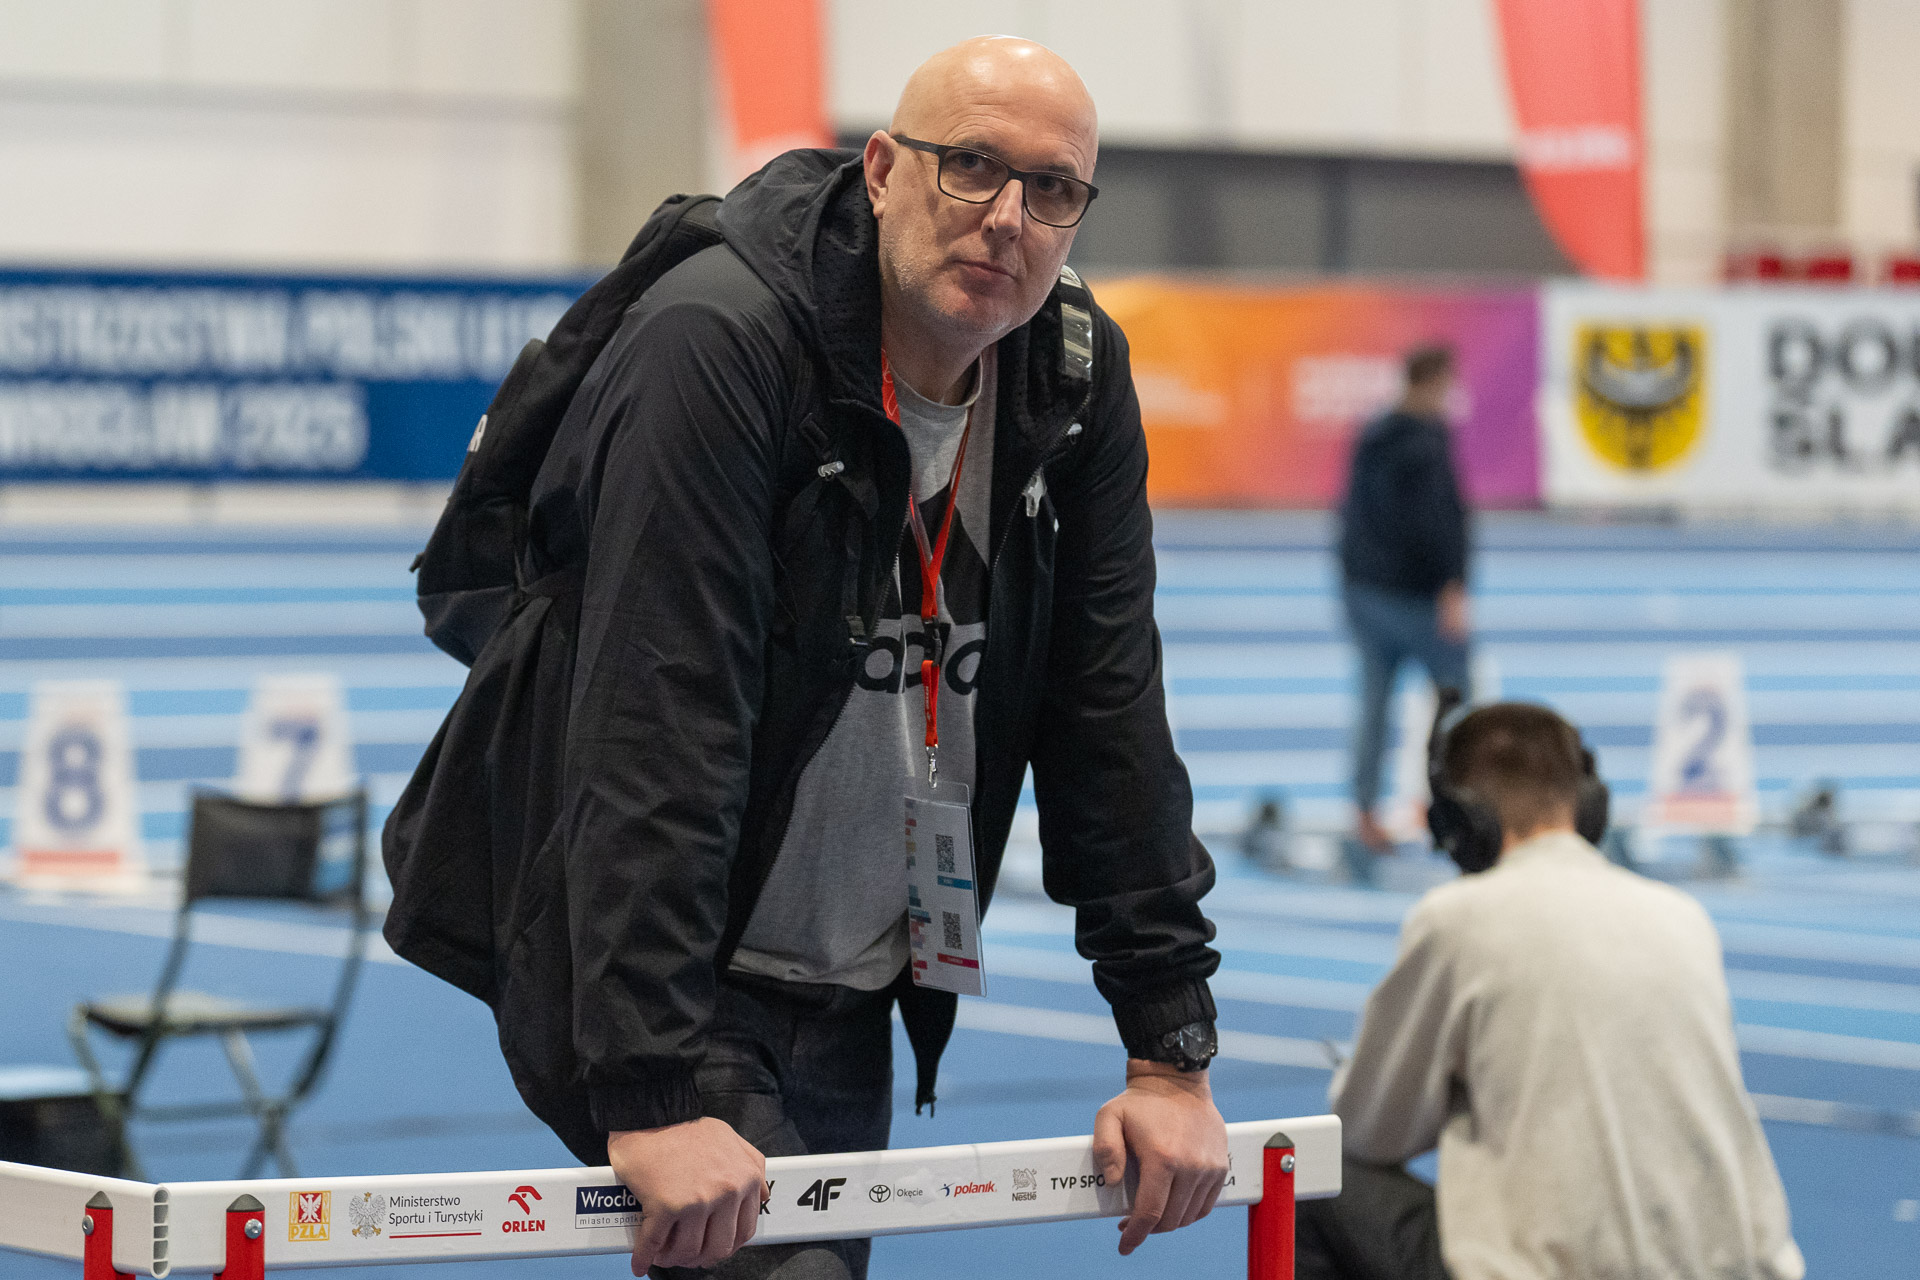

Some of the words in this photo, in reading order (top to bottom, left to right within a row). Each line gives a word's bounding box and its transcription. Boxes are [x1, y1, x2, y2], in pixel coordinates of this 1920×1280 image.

[1679, 685, 1730, 798] 2
[266, 714, 321, 806] 7
[46, 721, 106, 831] 8
[954, 1181, 996, 1198] polanik
[1051, 1177, 1077, 1190] TVP
[1080, 1174, 1105, 1189] SPO
[389, 1195, 461, 1208] Ministerstwo
[580, 1189, 636, 1208] Wrocła
[797, 1178, 847, 1212] 4F
[896, 1188, 923, 1199] Okęcie
[389, 1212, 425, 1227] Sportu
[428, 1211, 431, 1223] i
[435, 1210, 484, 1225] Turystyki
[502, 1220, 546, 1233] ORLEN
[579, 1216, 611, 1225] miasto
[614, 1214, 645, 1227] spotka
[290, 1224, 328, 1240] PZLA
